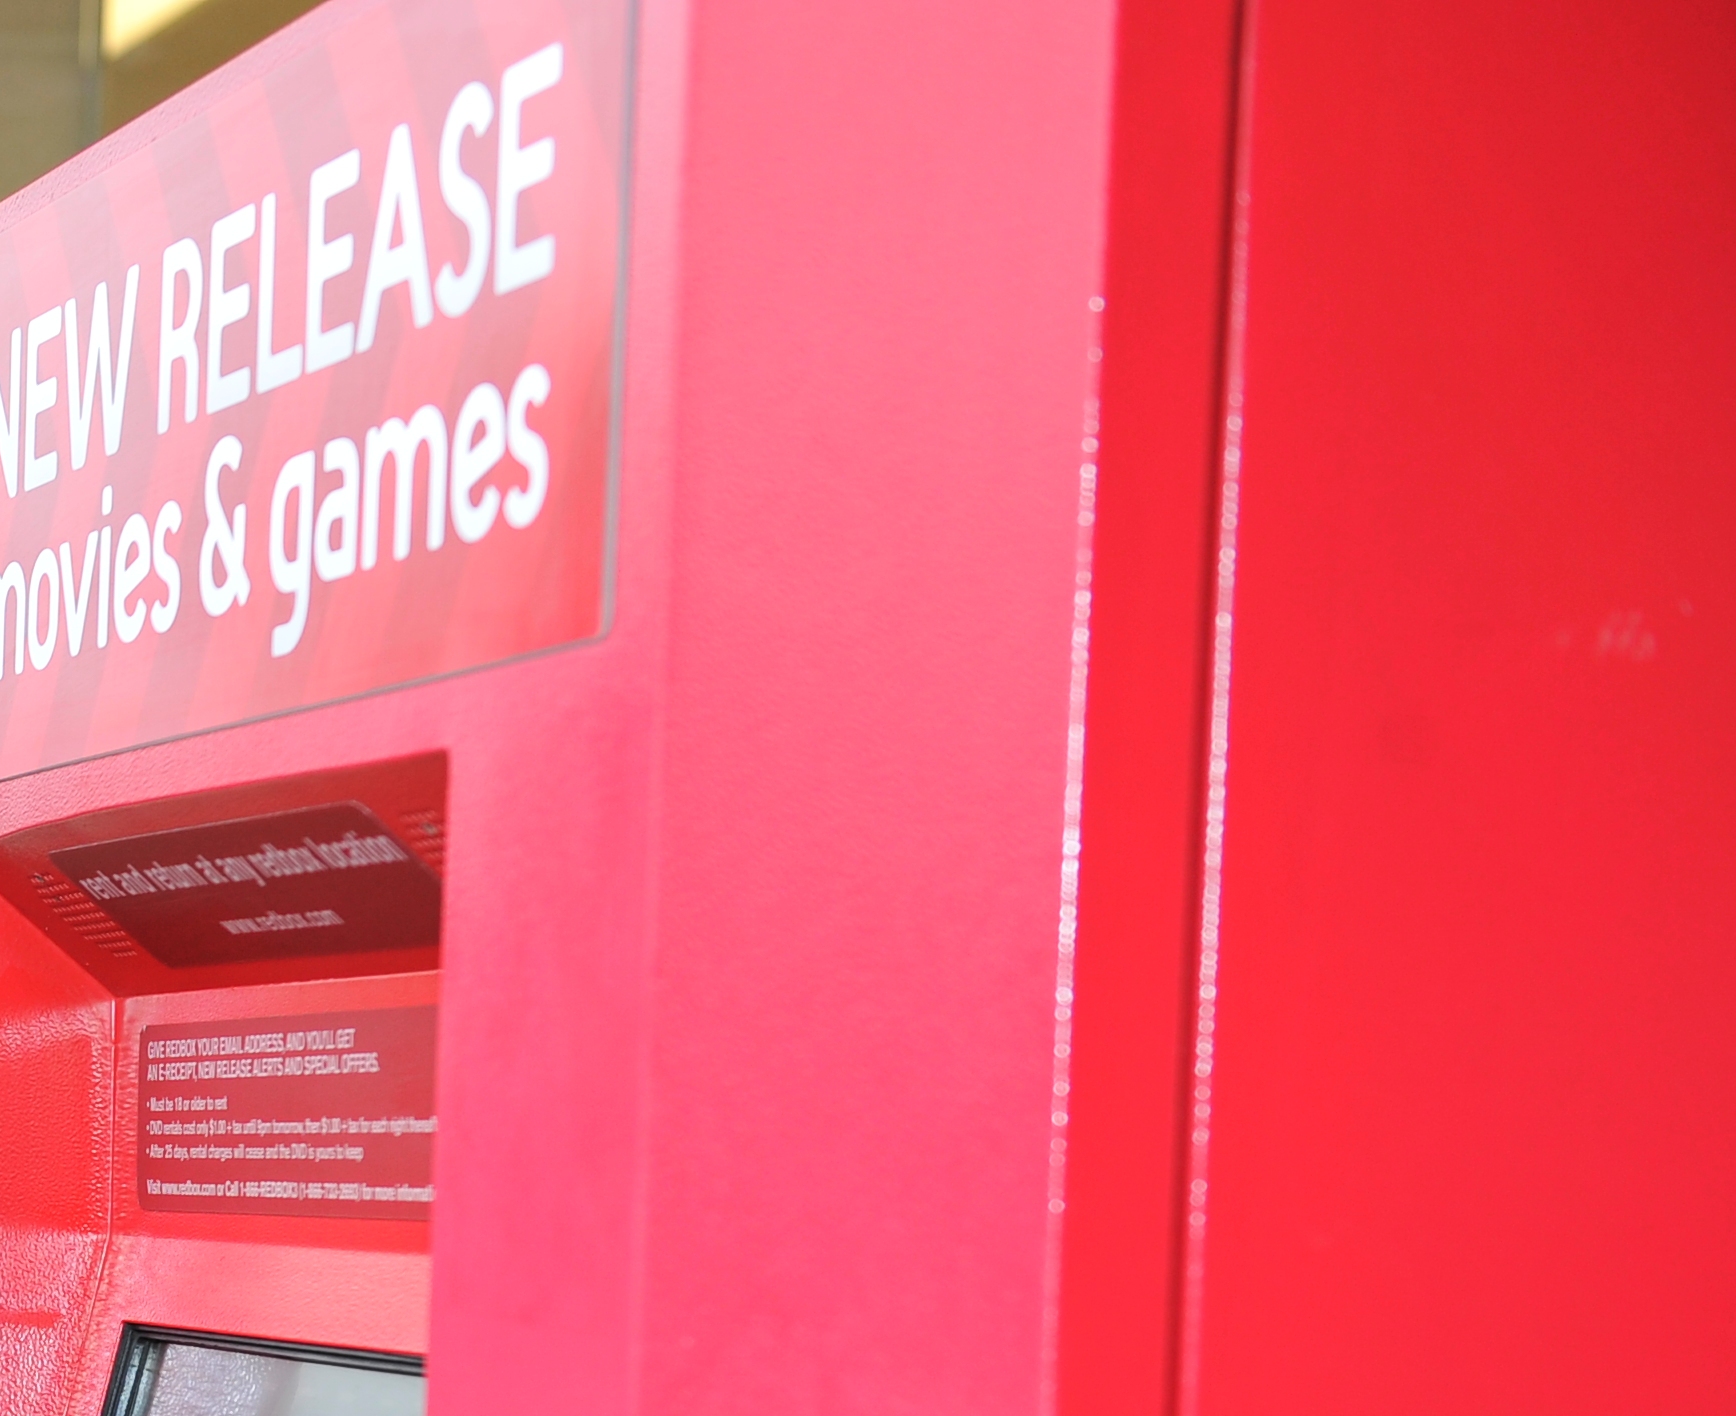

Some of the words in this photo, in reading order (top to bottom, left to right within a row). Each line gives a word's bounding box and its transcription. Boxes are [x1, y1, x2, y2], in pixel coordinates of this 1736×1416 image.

[157, 42, 564, 435] RELEASE
[198, 434, 252, 617] &
[268, 363, 552, 658] games
[79, 869, 126, 900] rent
[112, 863, 157, 896] and
[143, 860, 209, 891] return
[194, 854, 230, 885] at
[214, 854, 267, 887] any
[246, 842, 329, 878] redbox
[302, 830, 409, 869] location
[219, 909, 345, 935] www.redbox.com
[147, 1041, 165, 1059] GIVE
[165, 1039, 197, 1058] REDBOX
[197, 1038, 218, 1056] YOUR
[218, 1036, 243, 1055] EMAIL
[285, 1032, 305, 1051] AND
[335, 1028, 356, 1049] GET
[146, 1064, 158, 1081] AN
[198, 1061, 216, 1079] NEW
[216, 1059, 252, 1079] RELEASE
[252, 1057, 283, 1077] ALERTS
[284, 1056, 304, 1075] AND
[304, 1055, 340, 1076] SPECIAL
[150, 1097, 165, 1111] Must
[149, 1120, 163, 1135] DVD
[146, 1179, 162, 1196] Visit
[216, 1184, 224, 1197] or
[224, 1179, 239, 1197] Call
